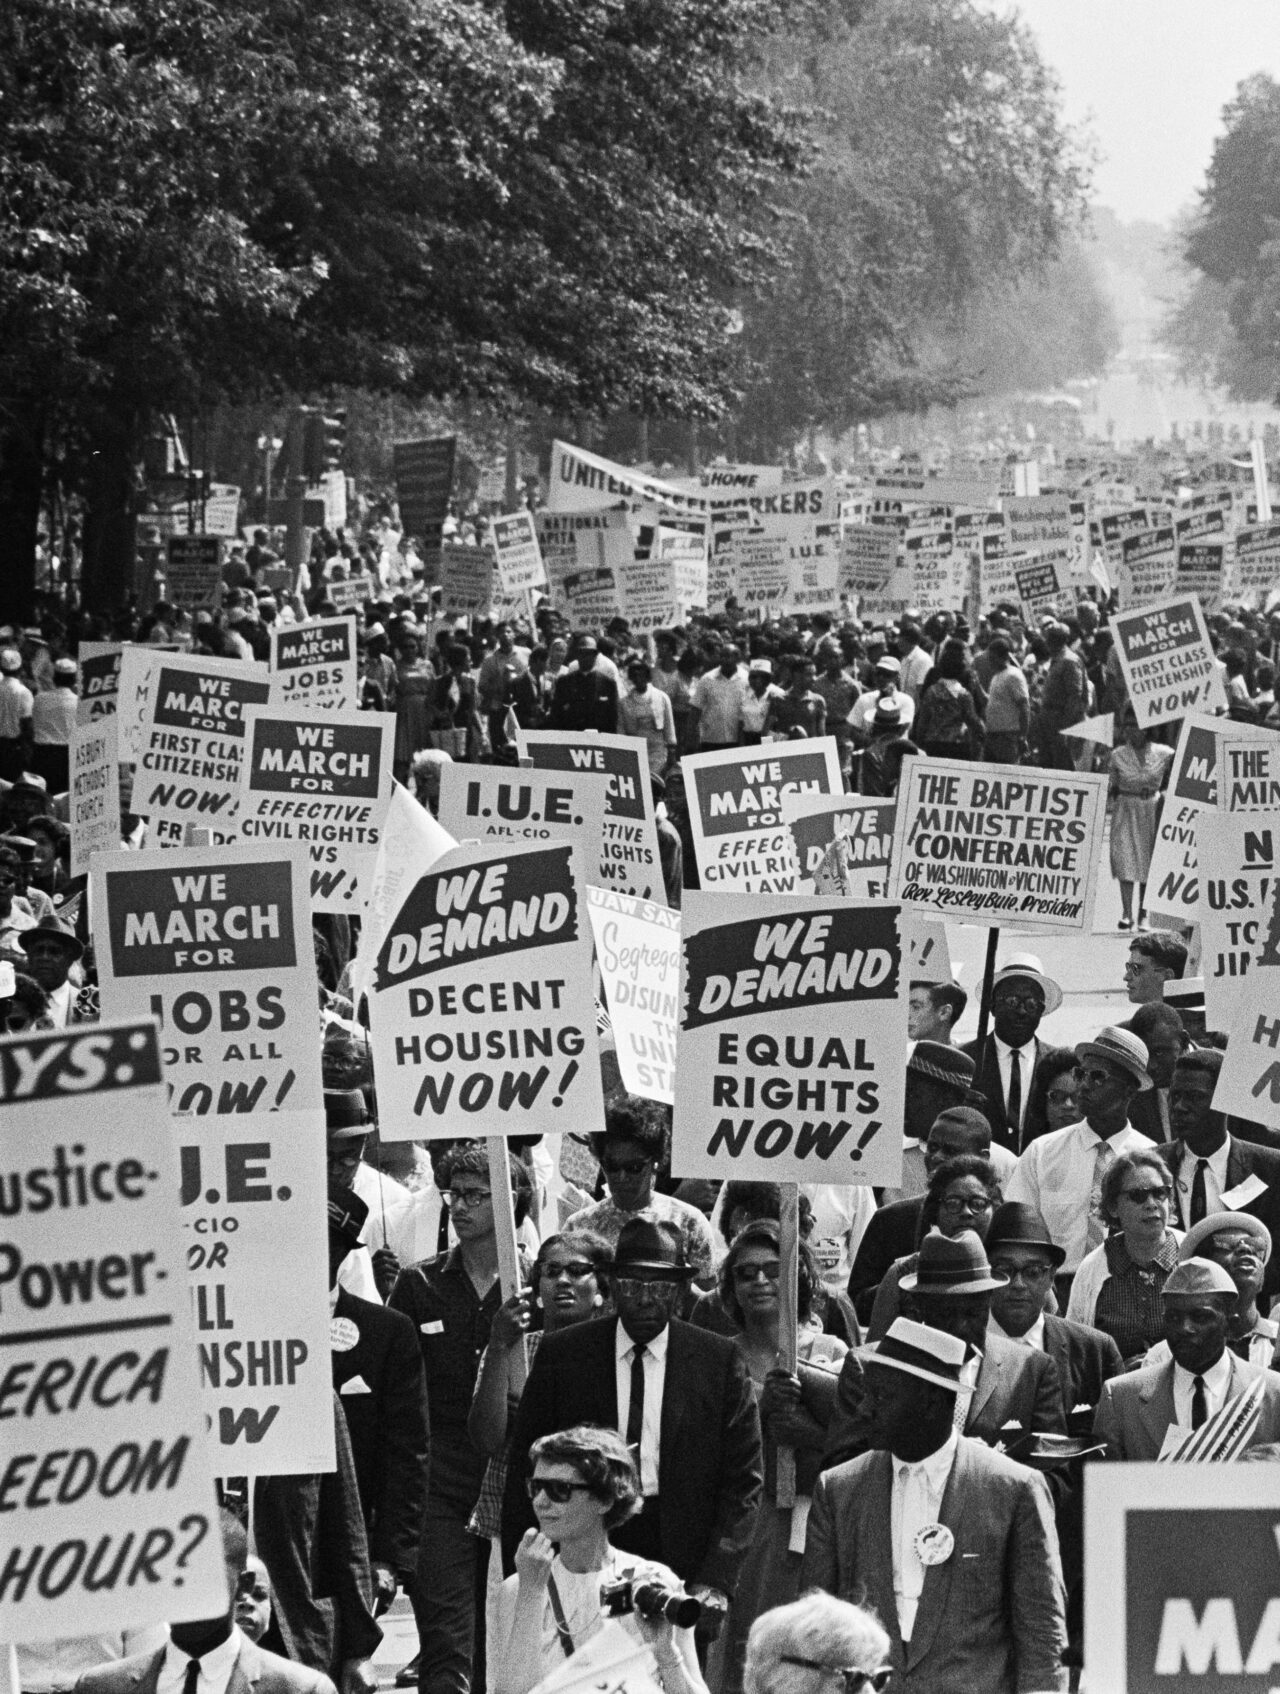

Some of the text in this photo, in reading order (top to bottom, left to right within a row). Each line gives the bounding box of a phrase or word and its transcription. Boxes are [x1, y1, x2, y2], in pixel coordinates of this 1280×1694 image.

[302, 628, 323, 642] WE
[1128, 618, 1194, 651] MARCH
[1144, 611, 1168, 628] WE
[282, 638, 344, 660] MARCH
[1150, 637, 1178, 652] FOR
[282, 668, 344, 691] JOBS
[1131, 647, 1208, 680] FIRST CLASS
[1131, 661, 1213, 696] CITIZENSHIP
[199, 677, 232, 697] WE
[1147, 681, 1212, 717] NOW!
[164, 691, 241, 720] MARC
[191, 716, 228, 731] FOR
[296, 726, 335, 748] WE
[150, 731, 201, 755] FIRST
[570, 748, 605, 769] WE
[142, 752, 241, 783] CITIZENSH
[260, 747, 370, 779] MARCH
[741, 762, 783, 784] WE
[1229, 750, 1270, 778] THE
[149, 783, 241, 817] NOW!
[290, 777, 334, 792] FOR
[918, 773, 1089, 818] THE BAPTIST
[256, 799, 372, 824] EFFECTIVE
[466, 781, 583, 825] I.U.E.
[241, 818, 294, 840] CIVIL
[300, 821, 380, 845] RIGHTS
[486, 824, 550, 840] AFL-CIO
[834, 810, 878, 836] WE
[907, 807, 1087, 846] MINISTERS
[915, 833, 1079, 872] CONFERANCE
[172, 873, 226, 903] WE
[704, 861, 762, 882] CIVIL
[905, 861, 1082, 896] OF WASHINGTON VICINITY
[435, 864, 508, 916] WE
[901, 882, 933, 903] Rev.
[1019, 894, 1084, 919] President
[1208, 878, 1254, 910] U.S.
[124, 904, 280, 946] MARCH
[590, 890, 638, 915] UAW
[642, 904, 681, 931] SAY
[387, 892, 570, 975] DEMAND
[754, 915, 833, 962] WE
[174, 948, 235, 967] FOR
[698, 948, 892, 1014] DEMAND
[408, 979, 566, 1018] DECENT
[223, 1041, 283, 1062] ALL
[394, 1025, 586, 1065] HOUSING
[718, 1033, 875, 1070] EQUAL
[168, 1069, 296, 1116] OW!
[413, 1059, 579, 1116] NOW!
[712, 1075, 880, 1114] RIGHTS
[706, 1118, 883, 1162] NOW!
[0, 1347, 170, 1420] ERICA
[0, 1435, 191, 1514] EEDOM
[0, 1513, 209, 1602] HOUR?
